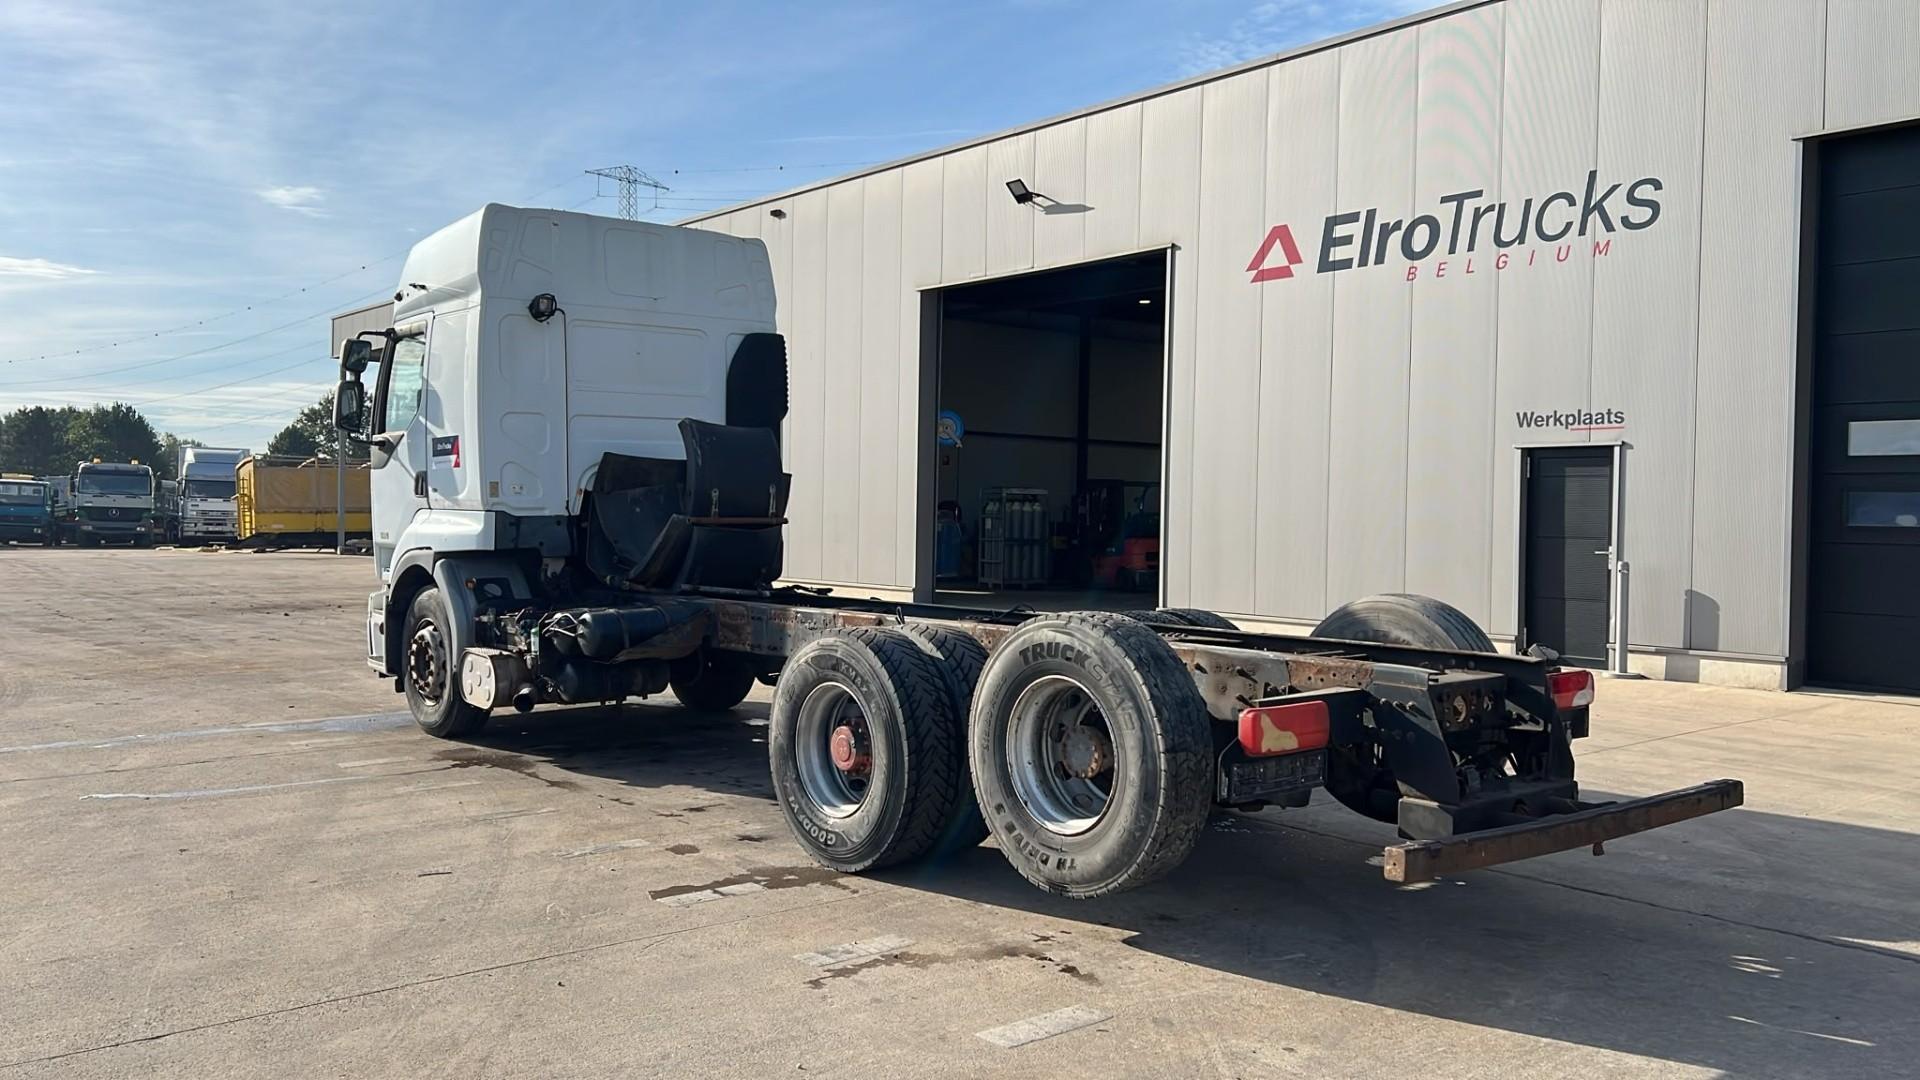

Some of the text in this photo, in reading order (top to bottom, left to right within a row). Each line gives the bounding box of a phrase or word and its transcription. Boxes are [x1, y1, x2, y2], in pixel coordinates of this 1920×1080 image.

[1317, 169, 1664, 274] ElroTrucks
[1406, 239, 1613, 282] BELGIUM
[1516, 408, 1625, 430] Werkplaats
